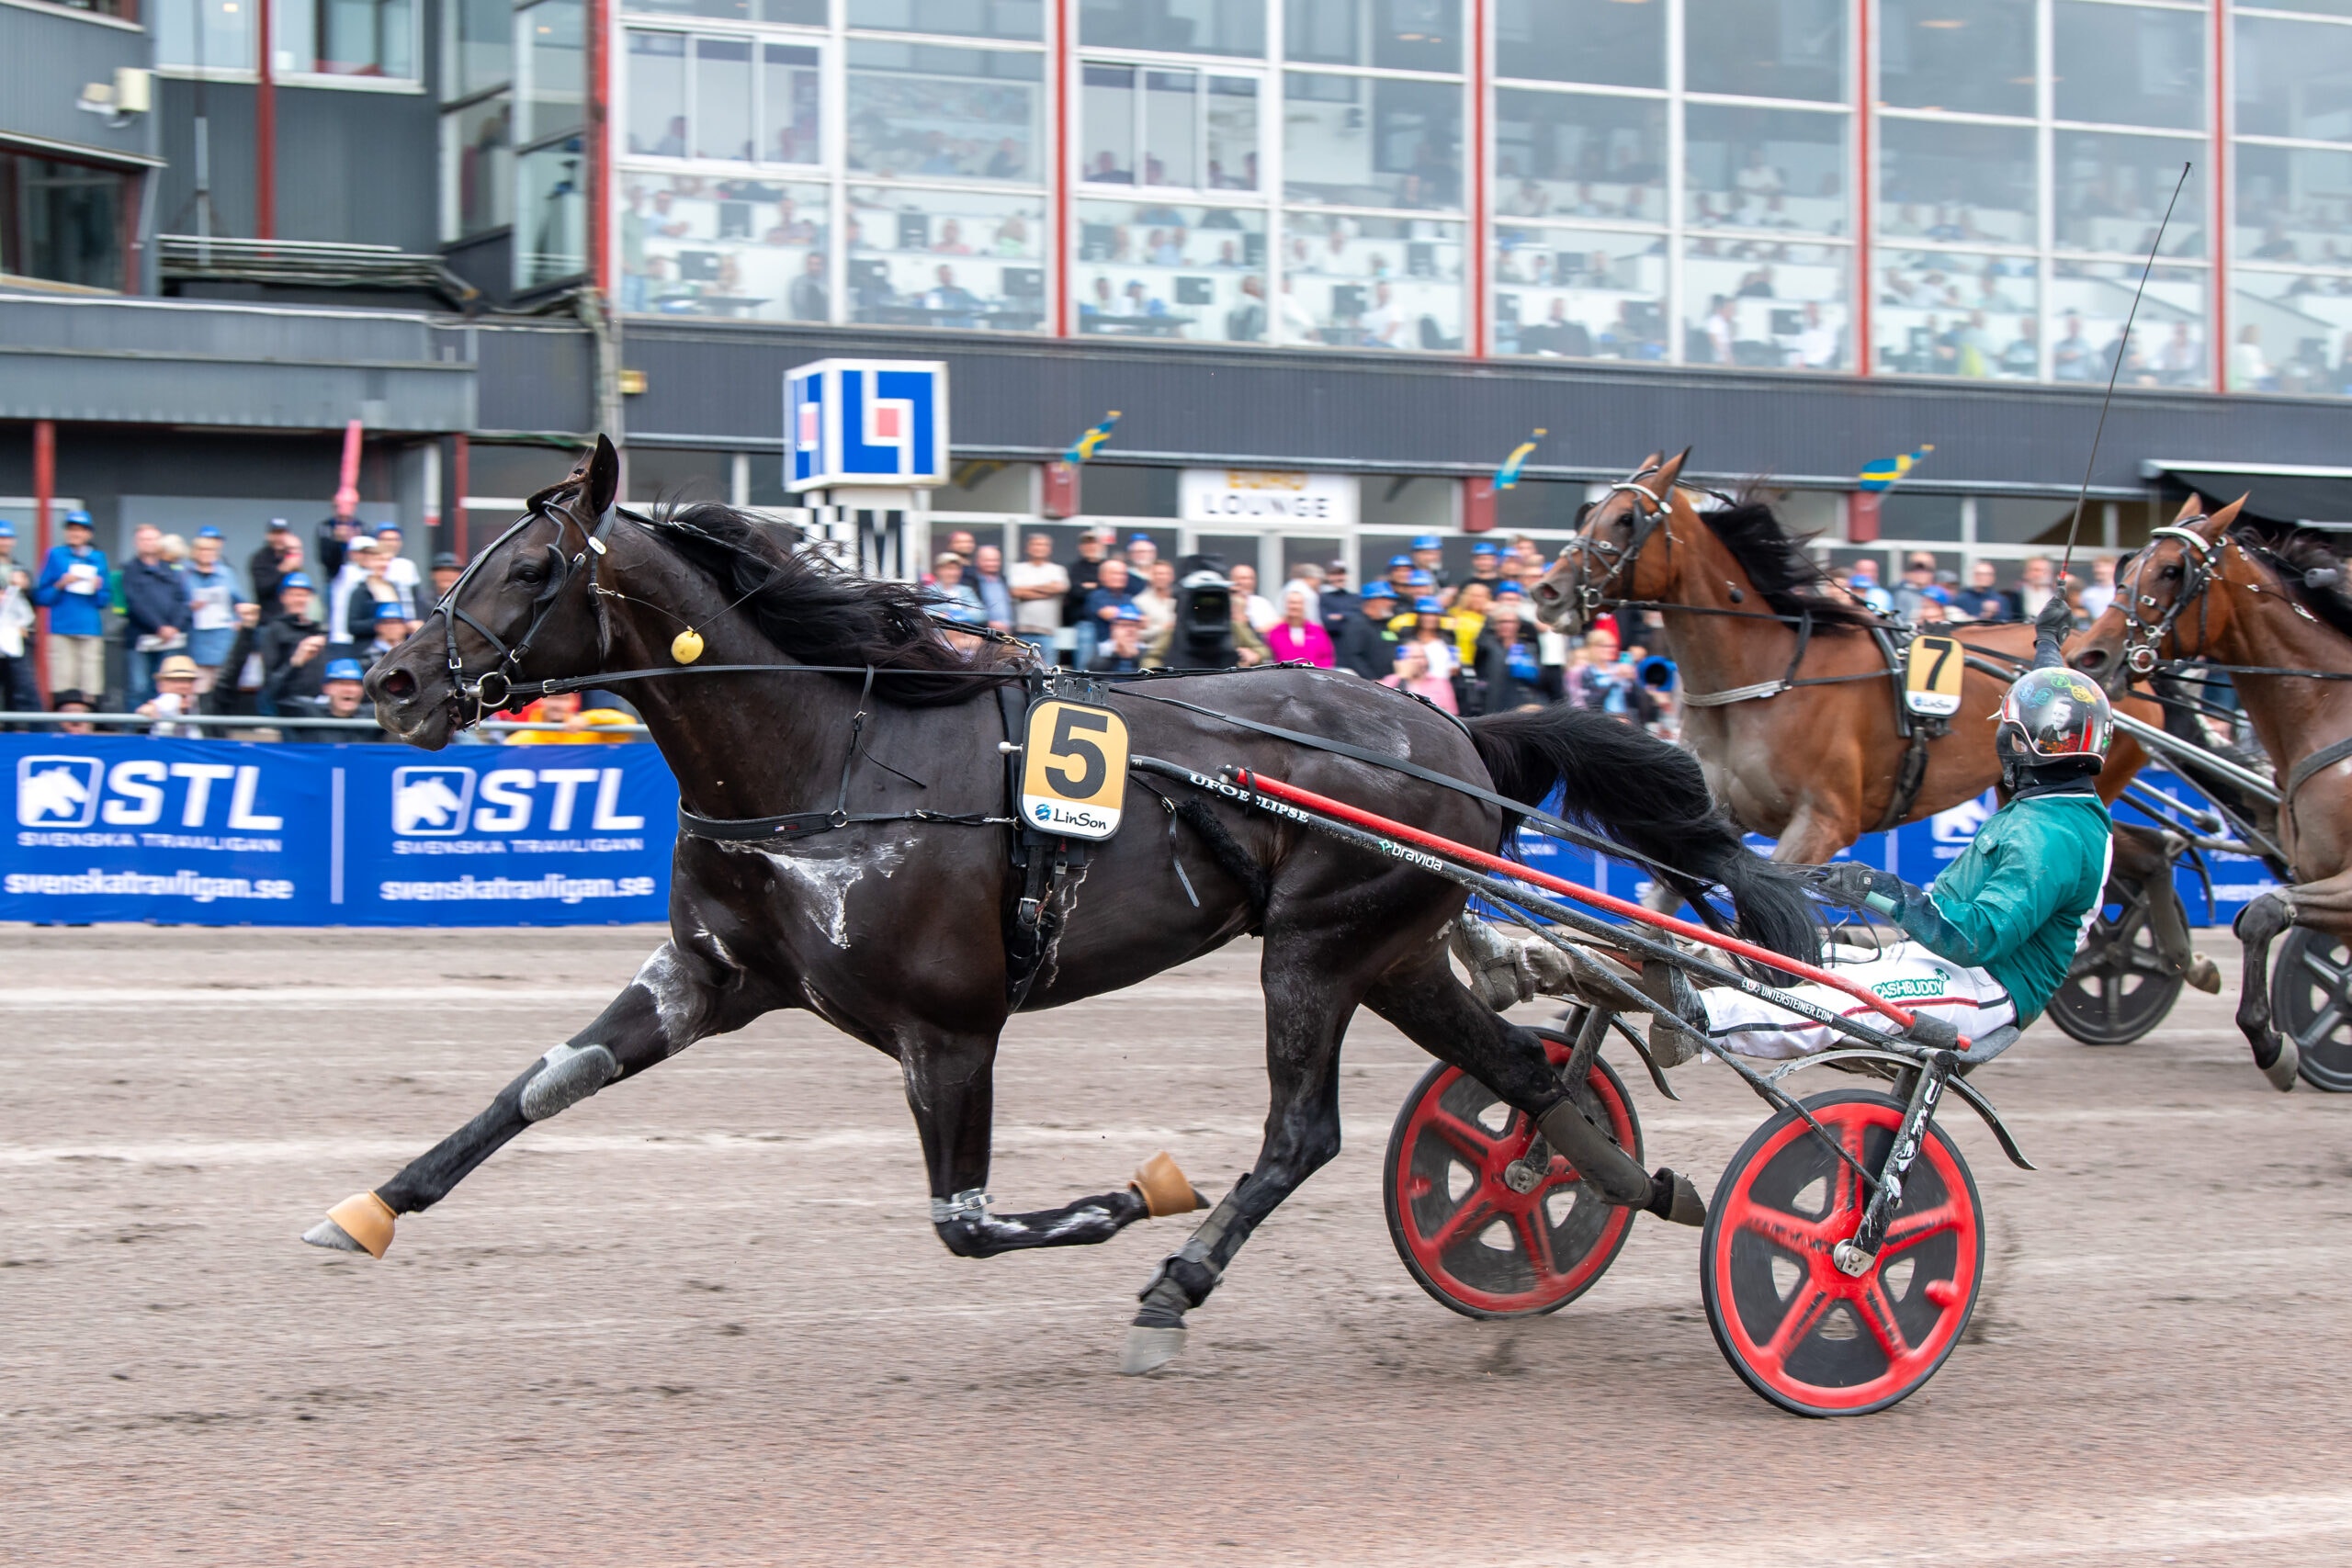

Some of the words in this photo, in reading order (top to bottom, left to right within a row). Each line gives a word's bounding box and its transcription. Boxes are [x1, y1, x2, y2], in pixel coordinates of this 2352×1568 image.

[1203, 494, 1330, 518] LOUNGE
[1923, 638, 1952, 691] 7
[1045, 706, 1108, 799] 5
[101, 760, 284, 830] STL
[473, 768, 645, 831] STL
[1054, 808, 1107, 830] LinSon
[17, 831, 137, 847] SVENSKA
[391, 840, 507, 854] SVENSKA
[1391, 842, 1443, 871] bravida
[4, 868, 296, 903] svenskatravligan.se
[379, 873, 656, 904] svenskatravligan.se
[1761, 986, 1834, 1023] UNTERSTEINER.COM
